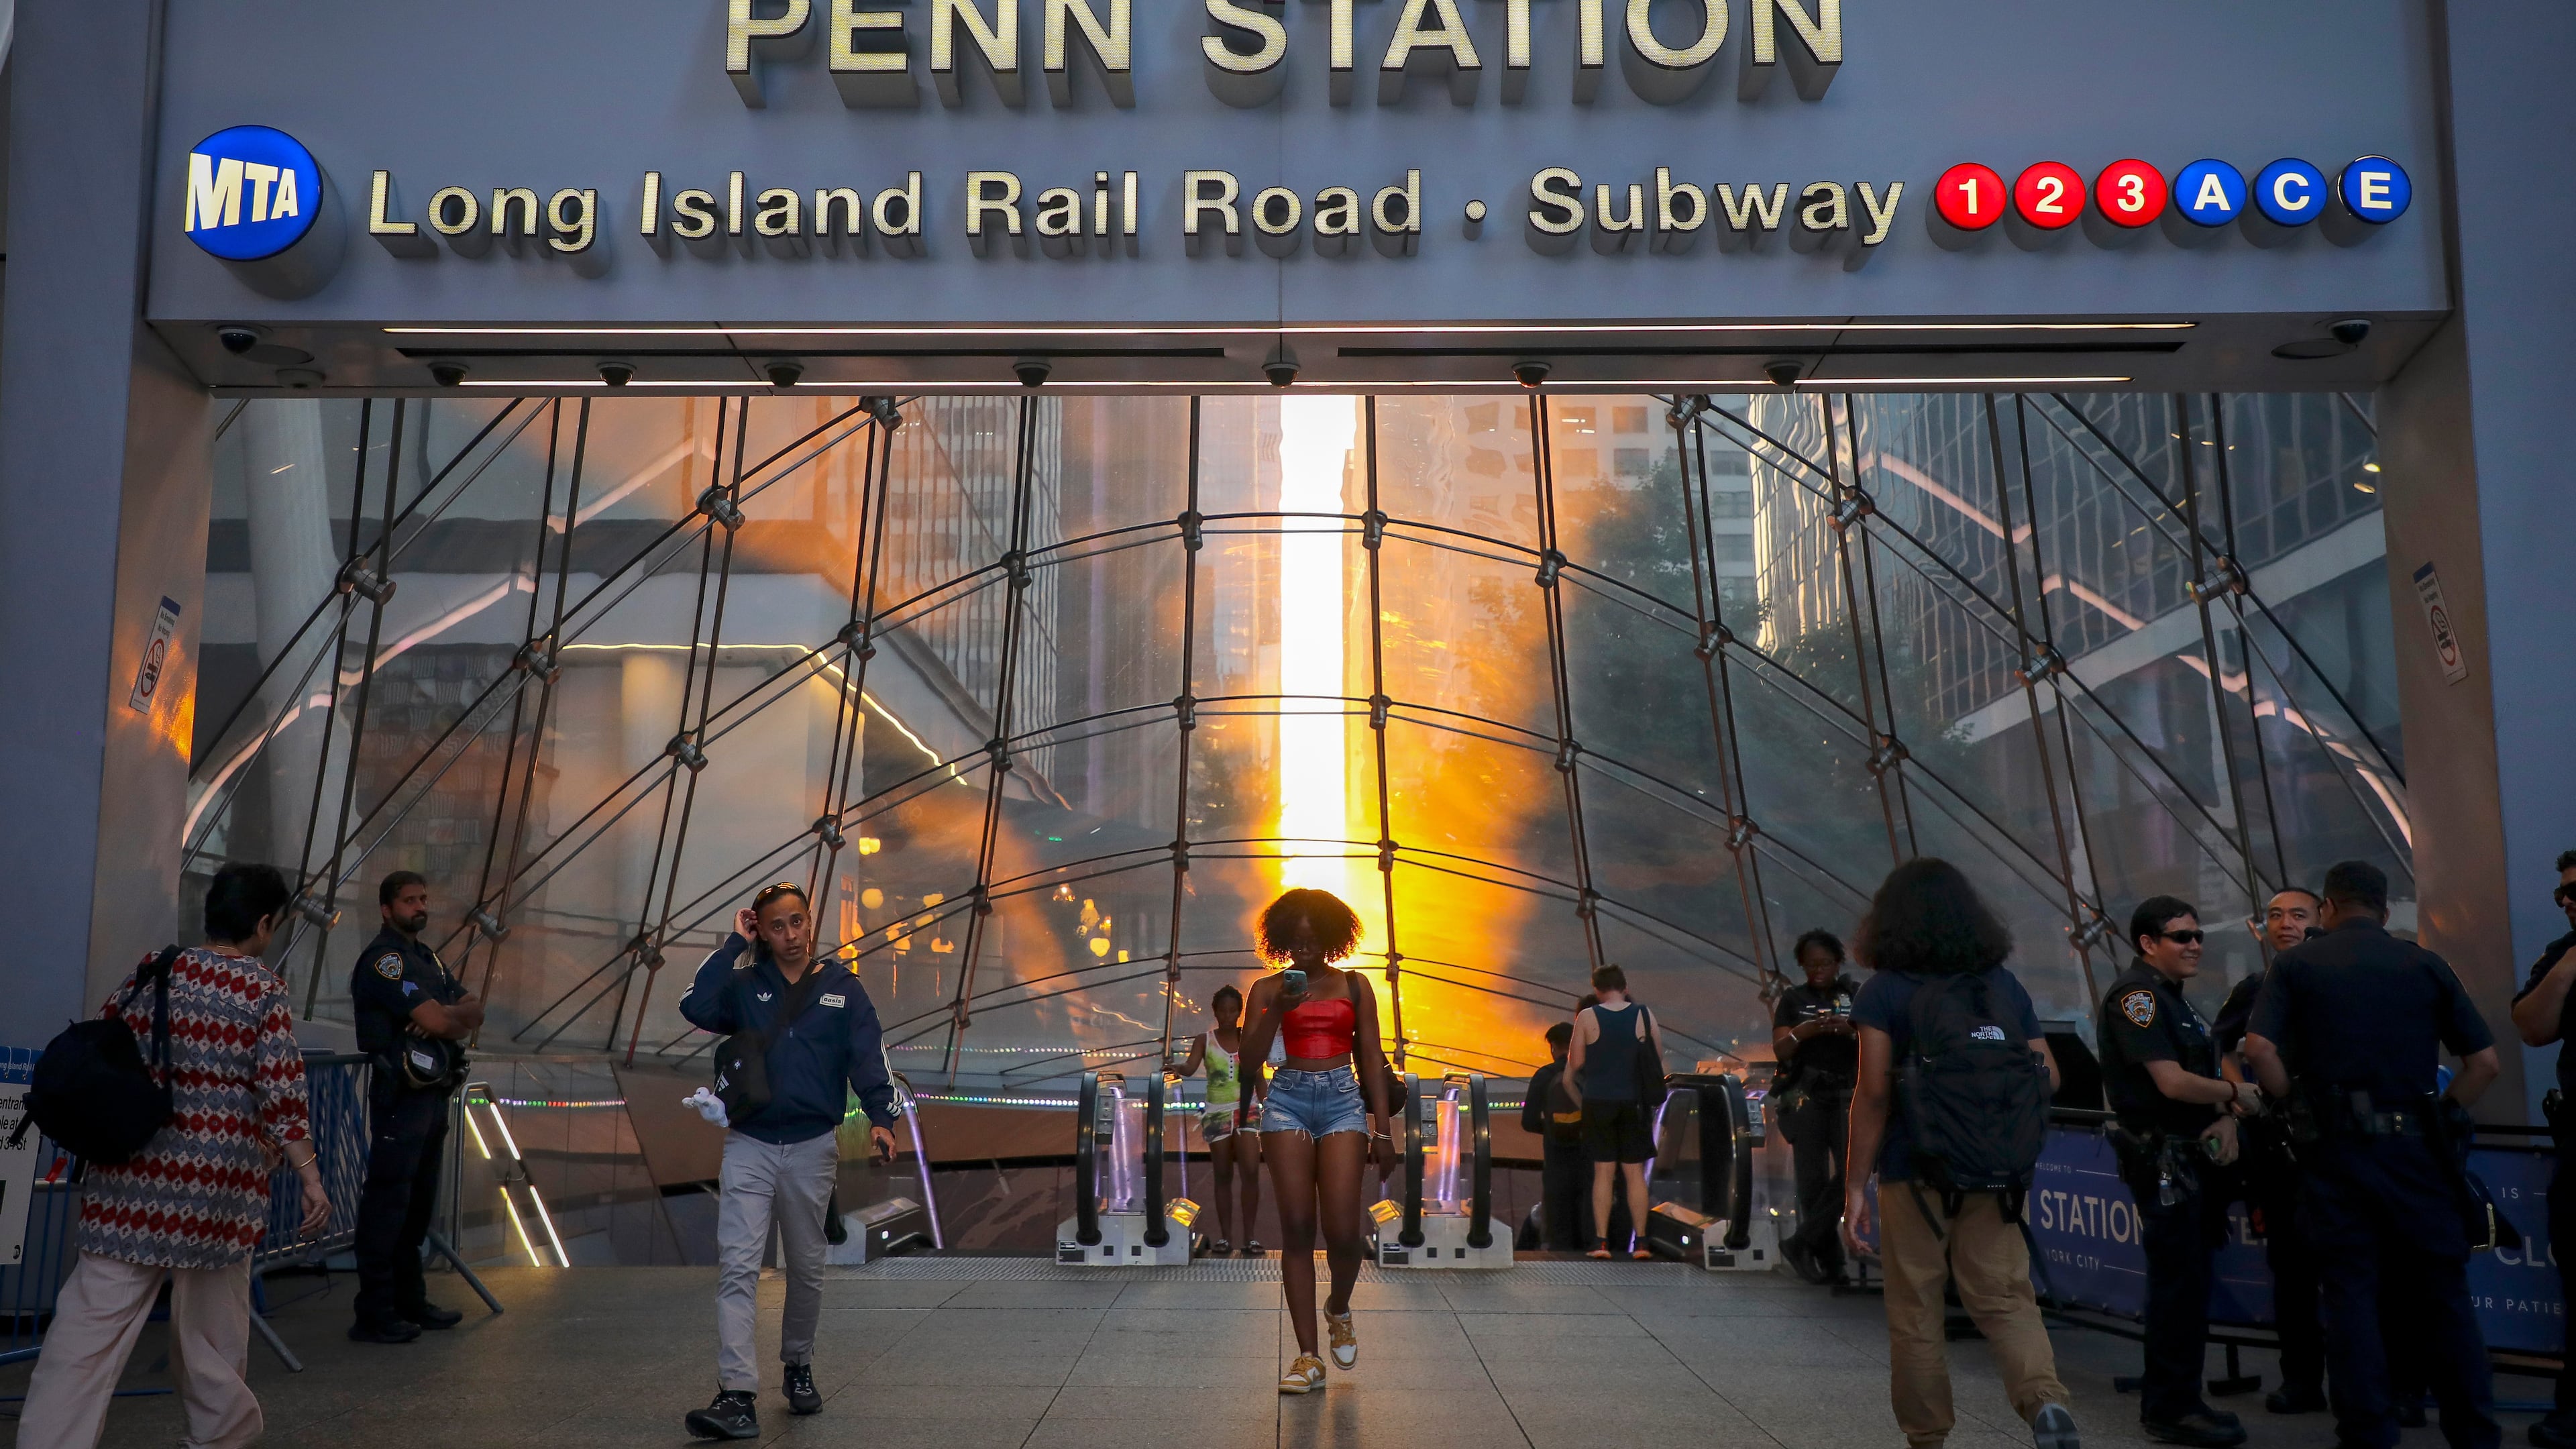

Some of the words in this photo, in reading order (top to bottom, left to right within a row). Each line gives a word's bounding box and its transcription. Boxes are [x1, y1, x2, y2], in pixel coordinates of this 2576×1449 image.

[725, 0, 1131, 74] PENN
[1201, 0, 1843, 71] STATION
[184, 152, 299, 232] MTA
[370, 170, 597, 252] Long
[641, 170, 921, 237] Island
[966, 170, 1138, 236] Rail
[1183, 169, 1421, 235] Road
[1529, 166, 1905, 246] Subway
[1958, 178, 1978, 214] 1
[2035, 176, 2064, 213] 2
[2116, 174, 2145, 212] 3
[2192, 173, 2232, 211] A
[2273, 172, 2310, 211] C
[2360, 171, 2393, 209] E
[2502, 1187, 2519, 1199] IS
[2077, 1254, 2100, 1272] CITY
[2506, 1299, 2564, 1314] PATIE
